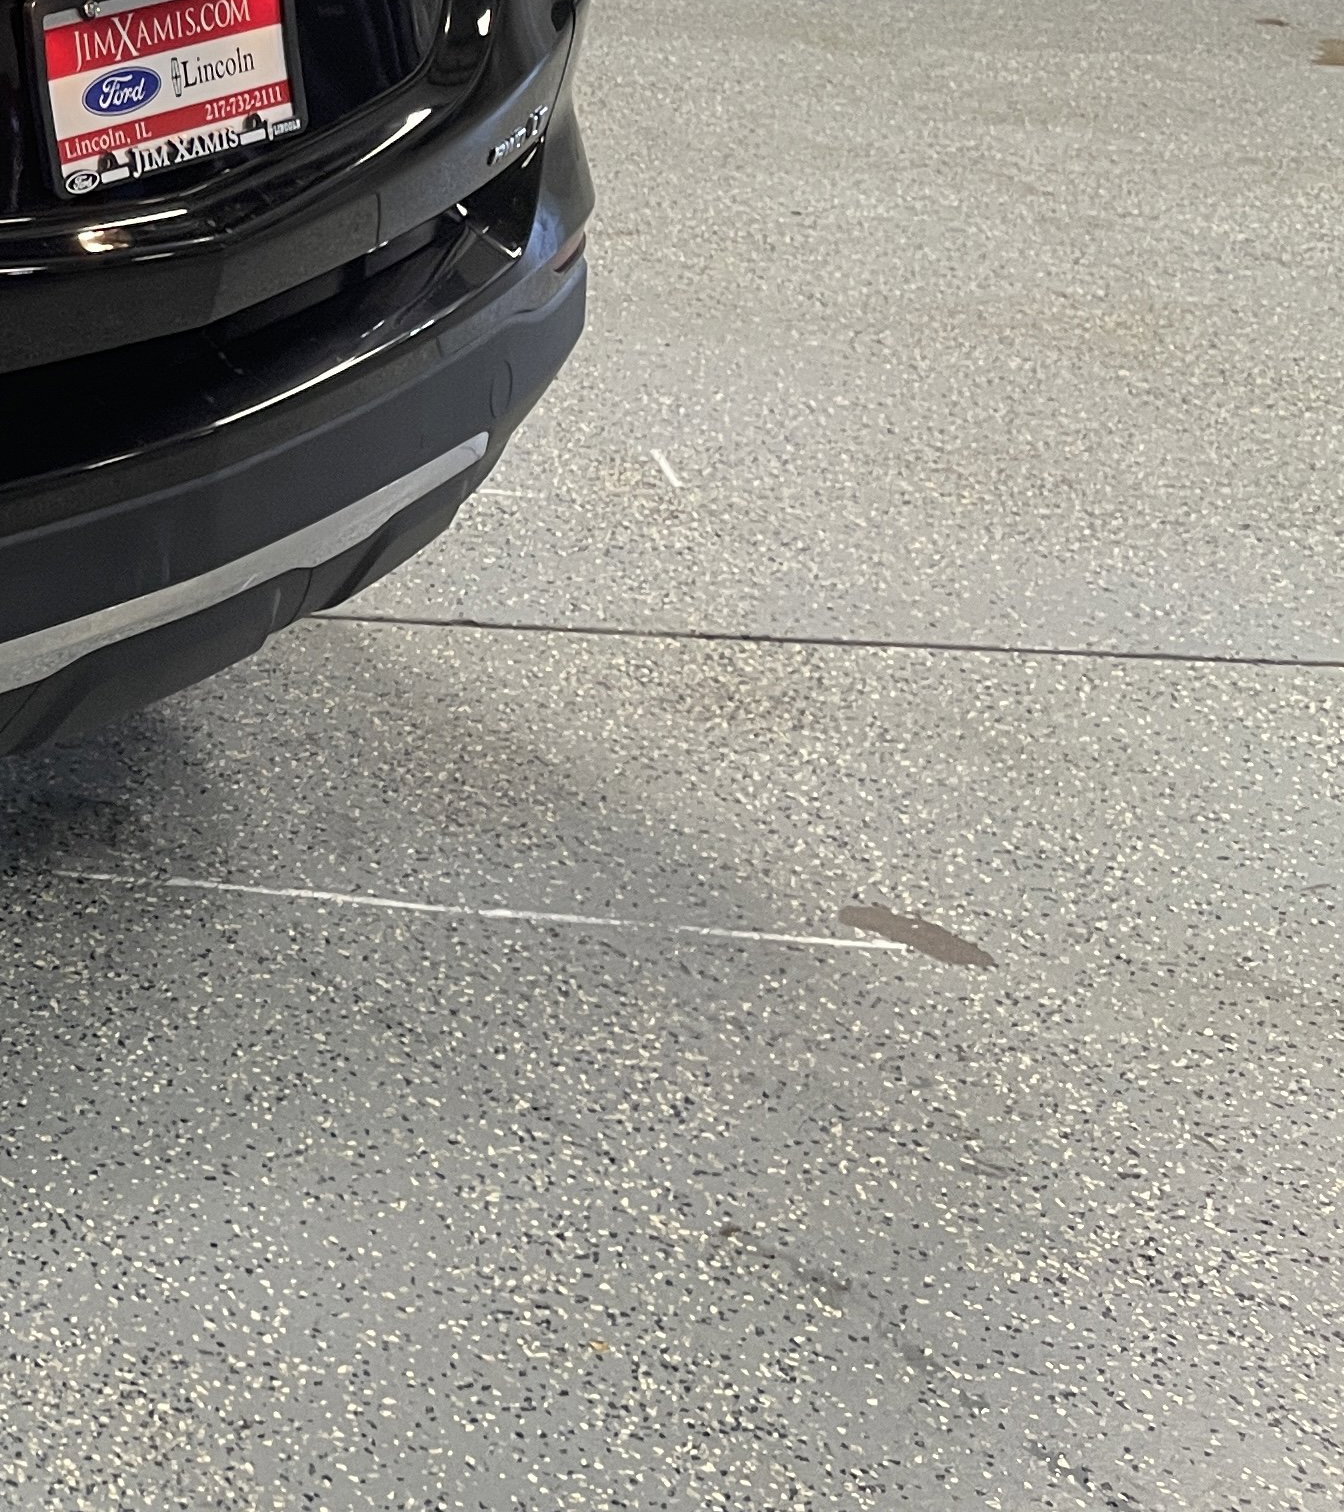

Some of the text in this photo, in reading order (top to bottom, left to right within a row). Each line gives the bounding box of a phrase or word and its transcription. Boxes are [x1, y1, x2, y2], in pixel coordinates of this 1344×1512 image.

[182, 47, 255, 89] Lincoln
[99, 74, 146, 109] Ford
[205, 85, 283, 121] 217-732-2111
[65, 122, 152, 159] Lincoln, IL
[132, 128, 240, 178] JIM XAMIS
